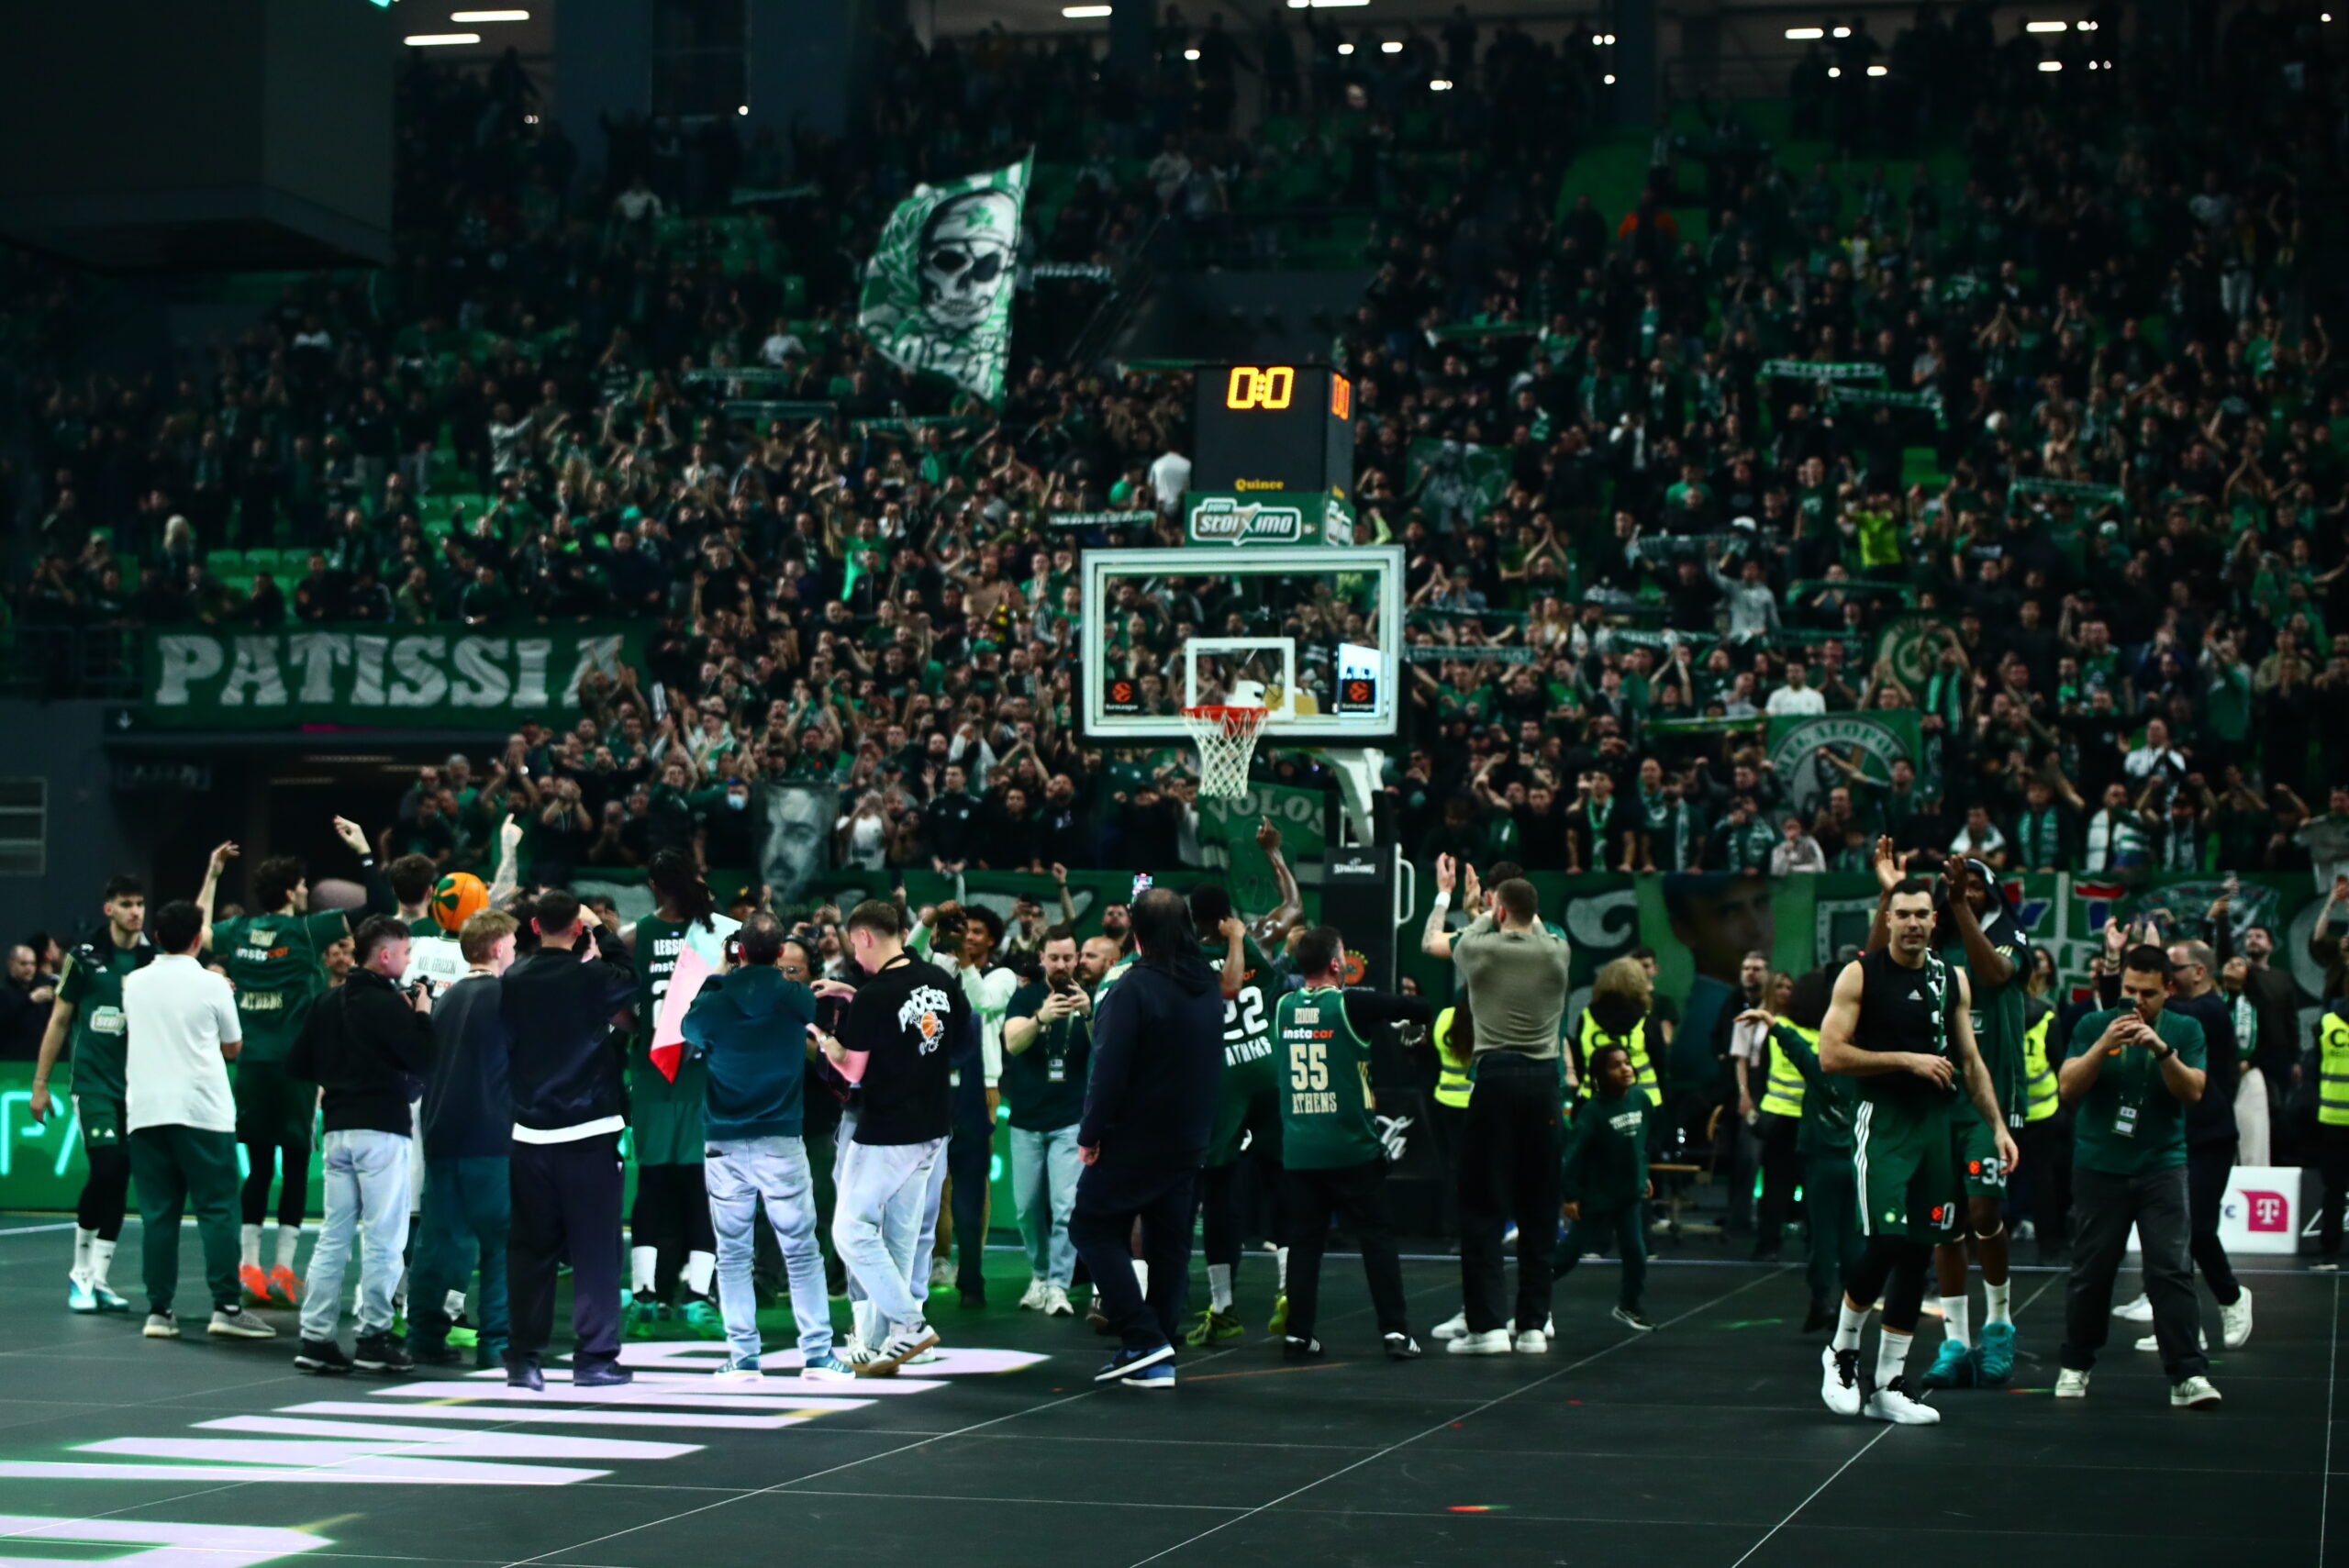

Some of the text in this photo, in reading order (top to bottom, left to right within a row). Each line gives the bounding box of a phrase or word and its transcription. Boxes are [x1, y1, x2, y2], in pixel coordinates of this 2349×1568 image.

[1234, 478, 1285, 492] Quince
[898, 989, 951, 1033] PROCESS
[1282, 1026, 1335, 1040] instacar
[1289, 1043, 1329, 1091] 55
[1291, 1092, 1337, 1115] ATHENS
